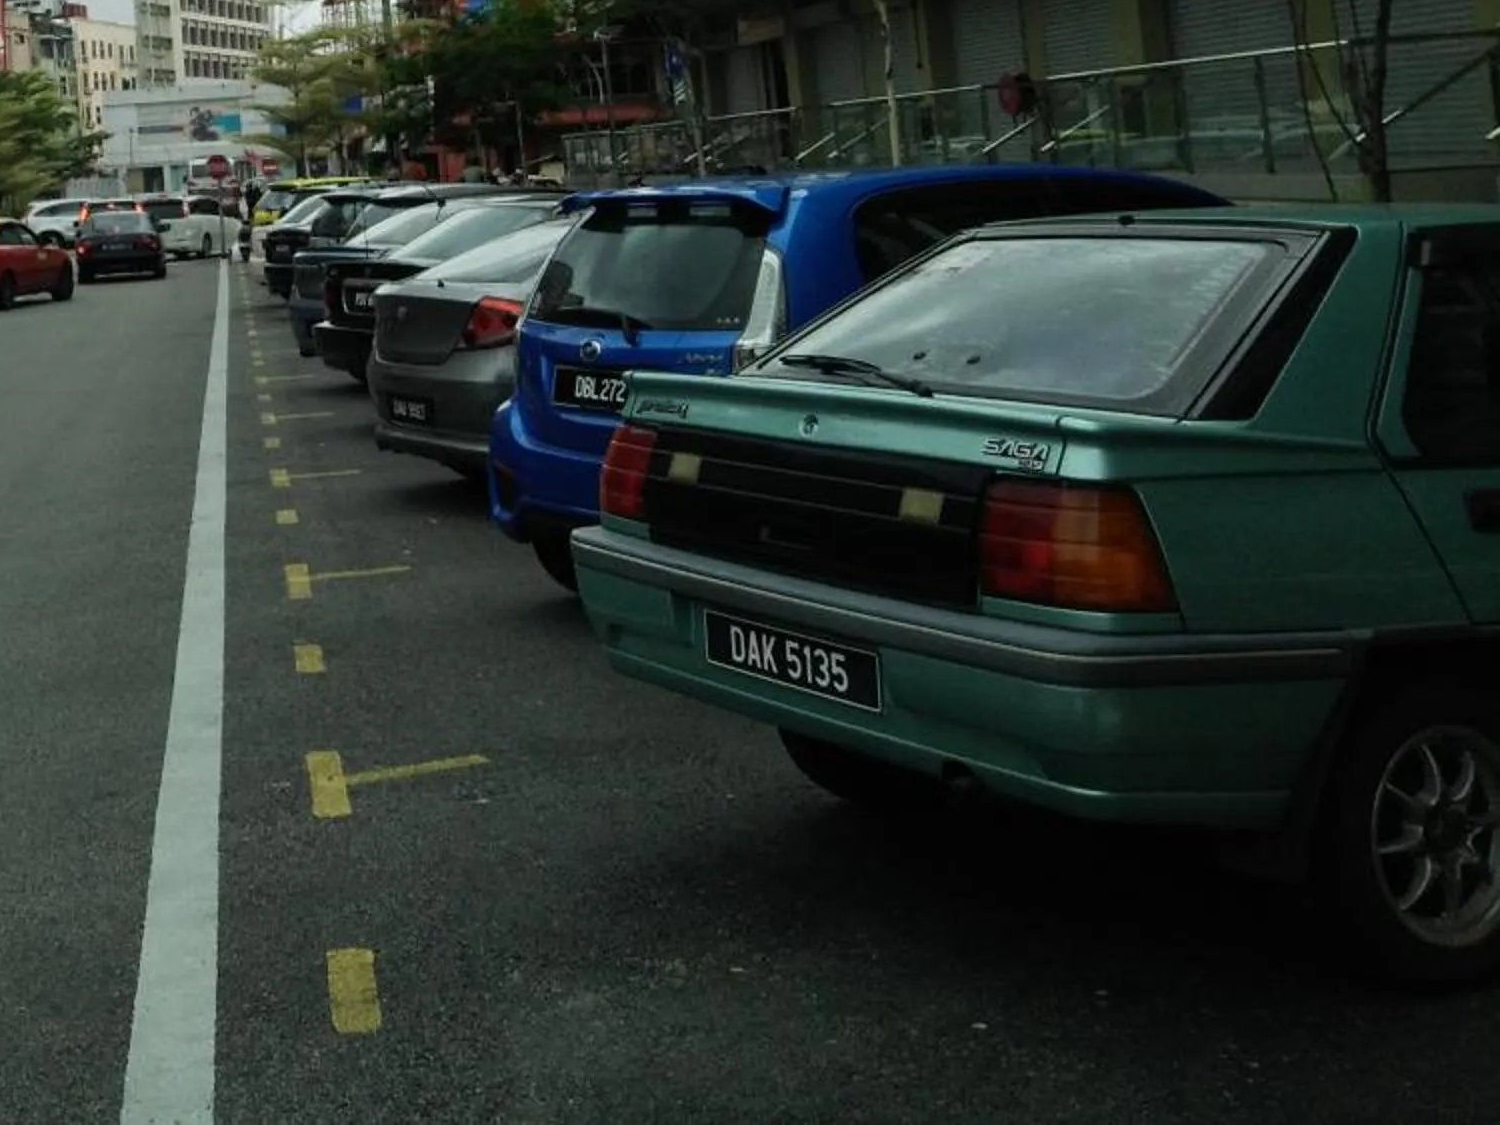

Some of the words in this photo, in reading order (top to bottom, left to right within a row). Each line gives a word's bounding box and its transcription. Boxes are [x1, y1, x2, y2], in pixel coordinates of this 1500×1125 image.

[574, 375, 599, 400] DBL
[980, 438, 1048, 460] SAGA
[729, 624, 779, 675] DAK
[784, 638, 850, 693] 5135
